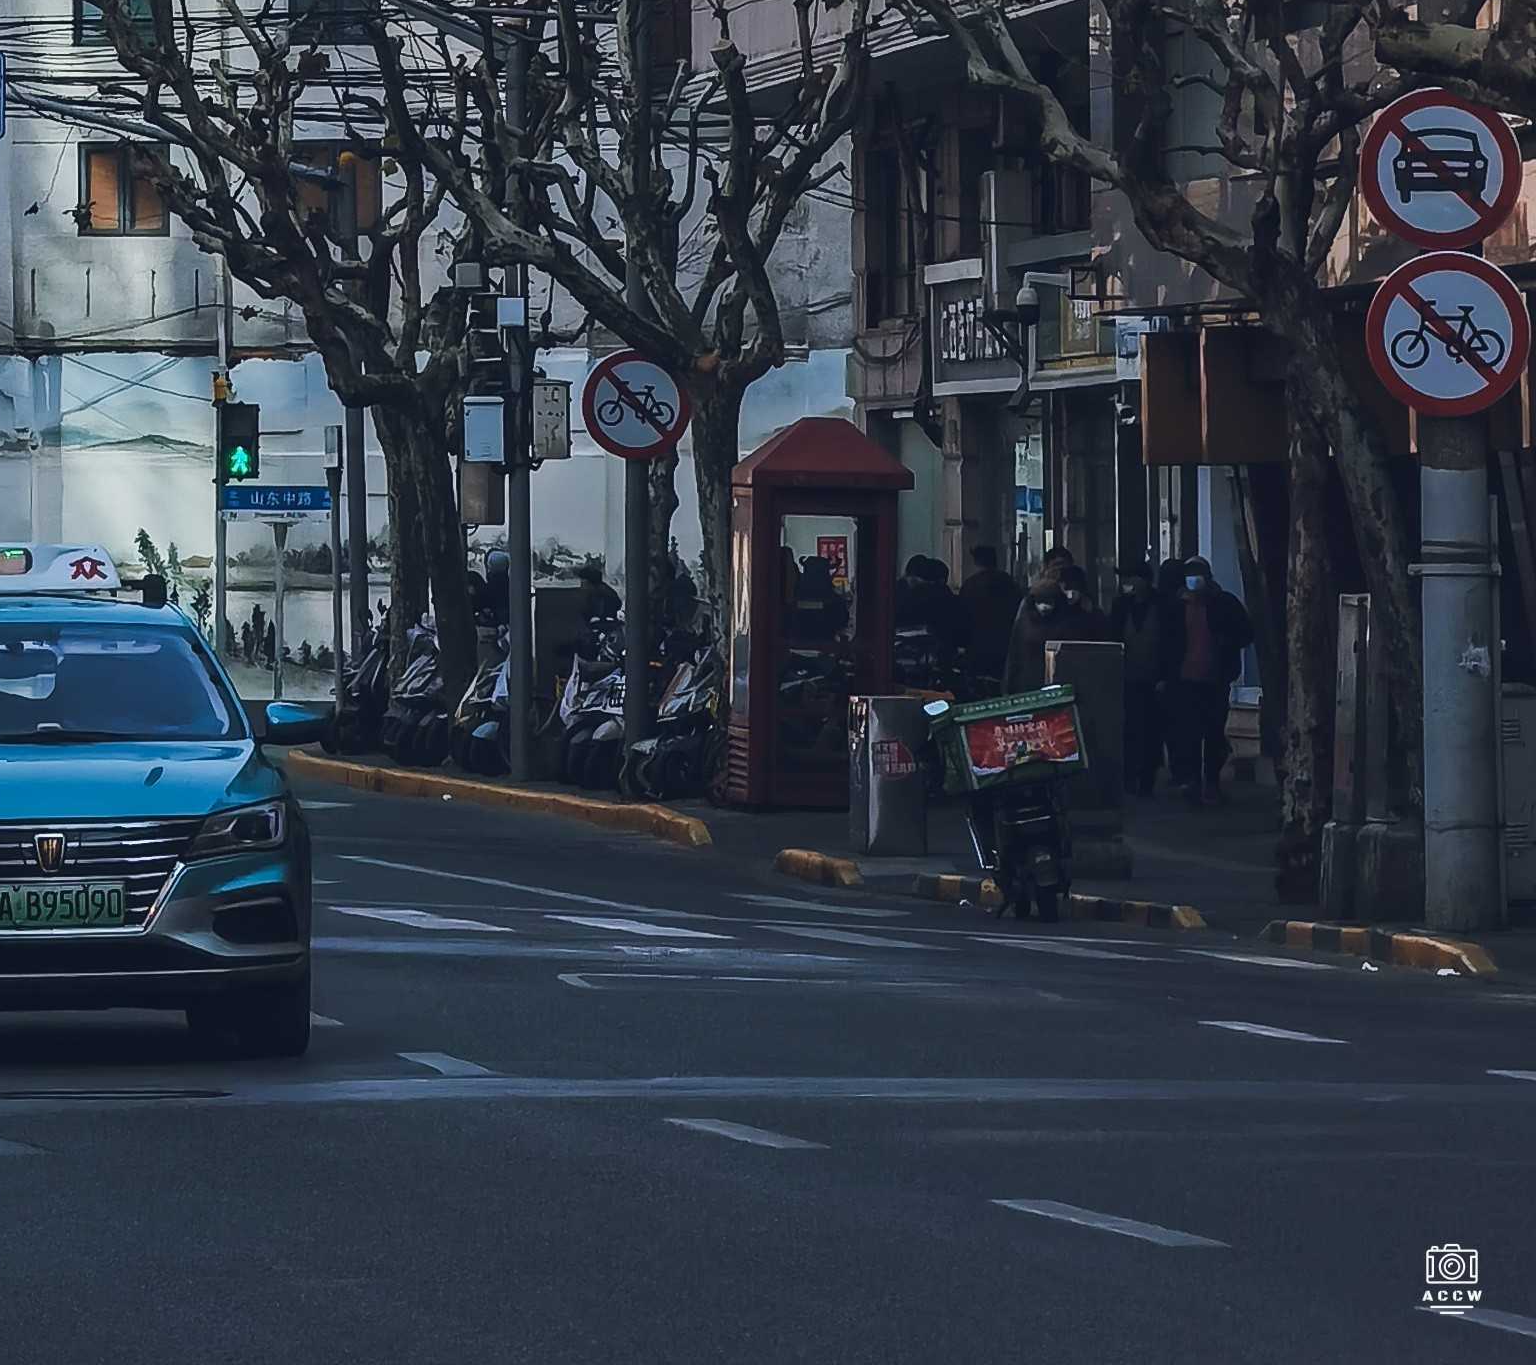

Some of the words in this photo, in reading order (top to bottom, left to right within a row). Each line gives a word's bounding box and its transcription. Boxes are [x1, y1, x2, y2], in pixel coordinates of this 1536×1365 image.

[250, 490, 312, 506] 山东中路
[68, 556, 109, 580] 众
